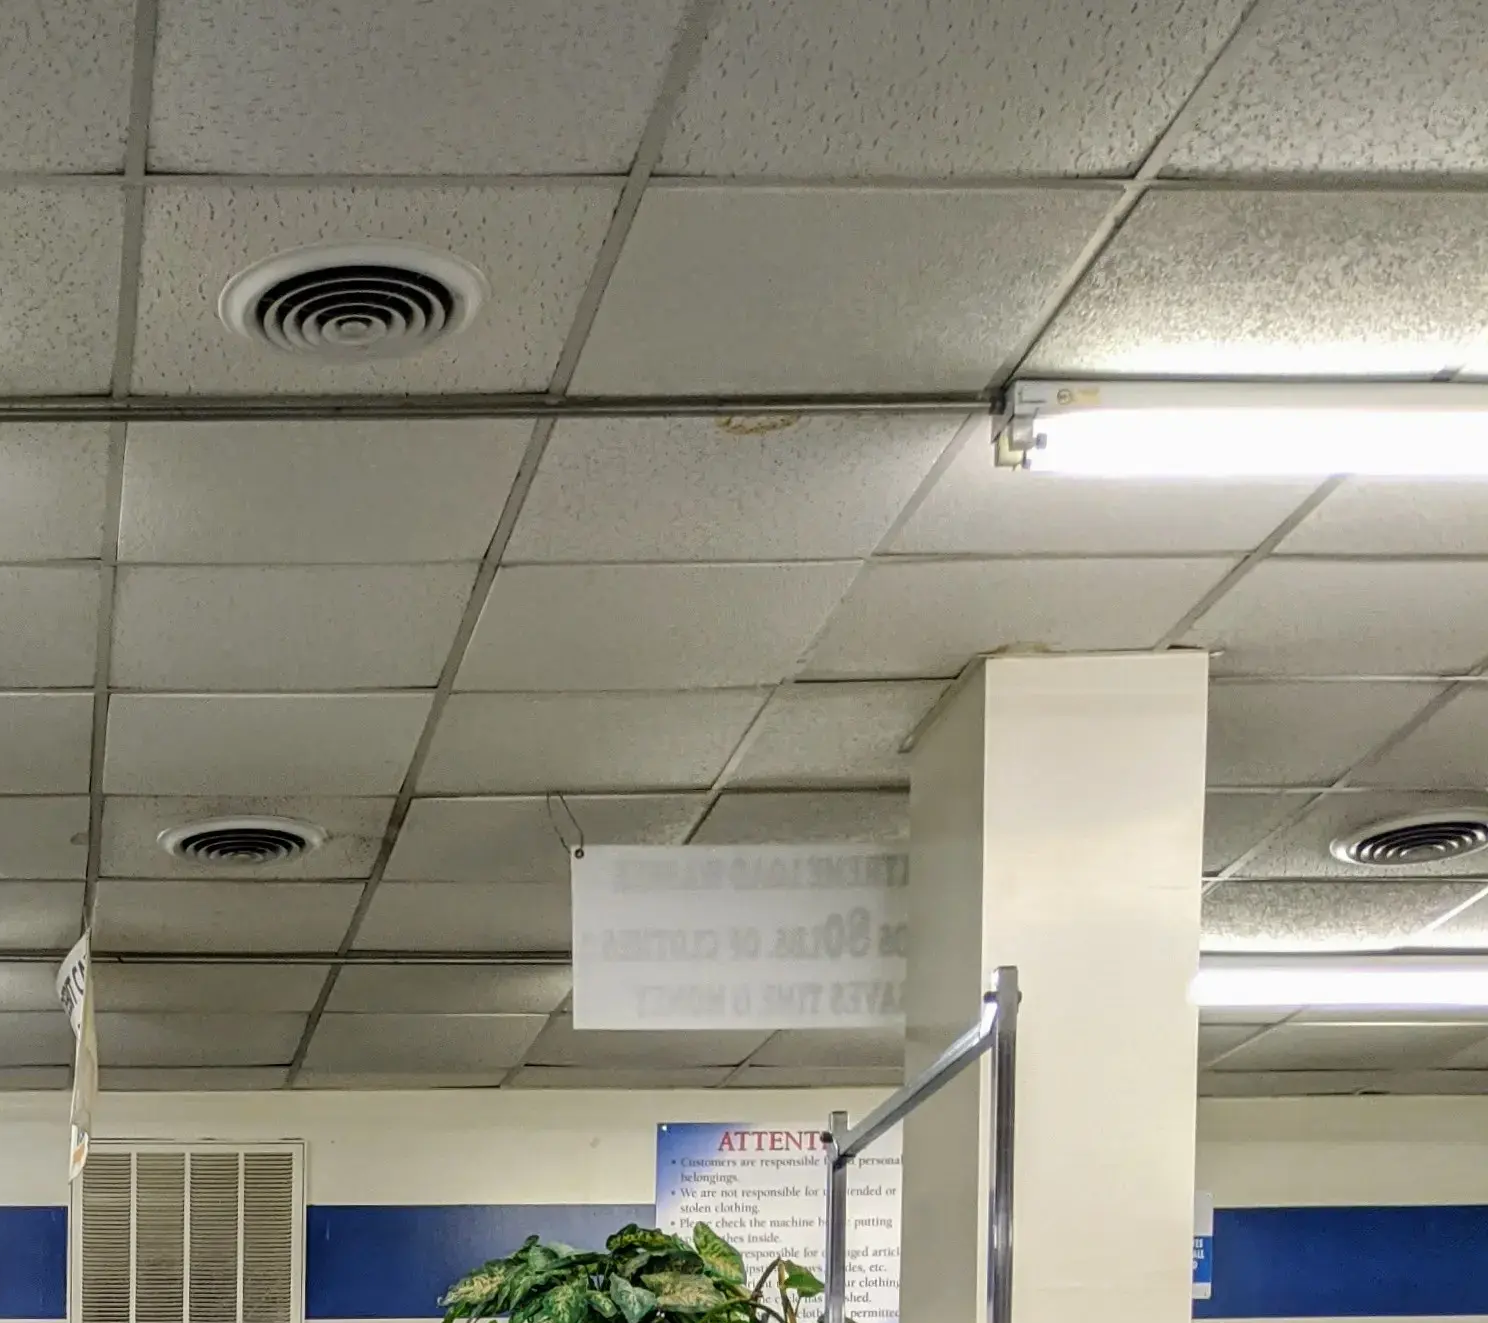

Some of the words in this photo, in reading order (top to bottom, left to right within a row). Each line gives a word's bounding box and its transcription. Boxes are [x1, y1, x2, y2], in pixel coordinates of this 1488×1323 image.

[680, 1157, 737, 1168] Customers
[740, 1159, 754, 1167] are
[760, 1156, 820, 1170] responsible
[680, 1187, 697, 1198] We
[700, 1190, 717, 1198] are
[720, 1189, 737, 1198] not
[741, 1186, 800, 1200] responsible
[804, 1186, 819, 1196] for
[885, 1187, 896, 1196] or
[680, 1202, 711, 1214] stolen
[715, 1202, 760, 1216] clothing.
[715, 1217, 746, 1228] check
[749, 1217, 766, 1227] the
[769, 1216, 815, 1228] machine
[854, 1216, 893, 1230] putting
[748, 1232, 780, 1243] inside.
[741, 1247, 800, 1261] responsible
[803, 1247, 818, 1257] for
[869, 1263, 887, 1273] etc.
